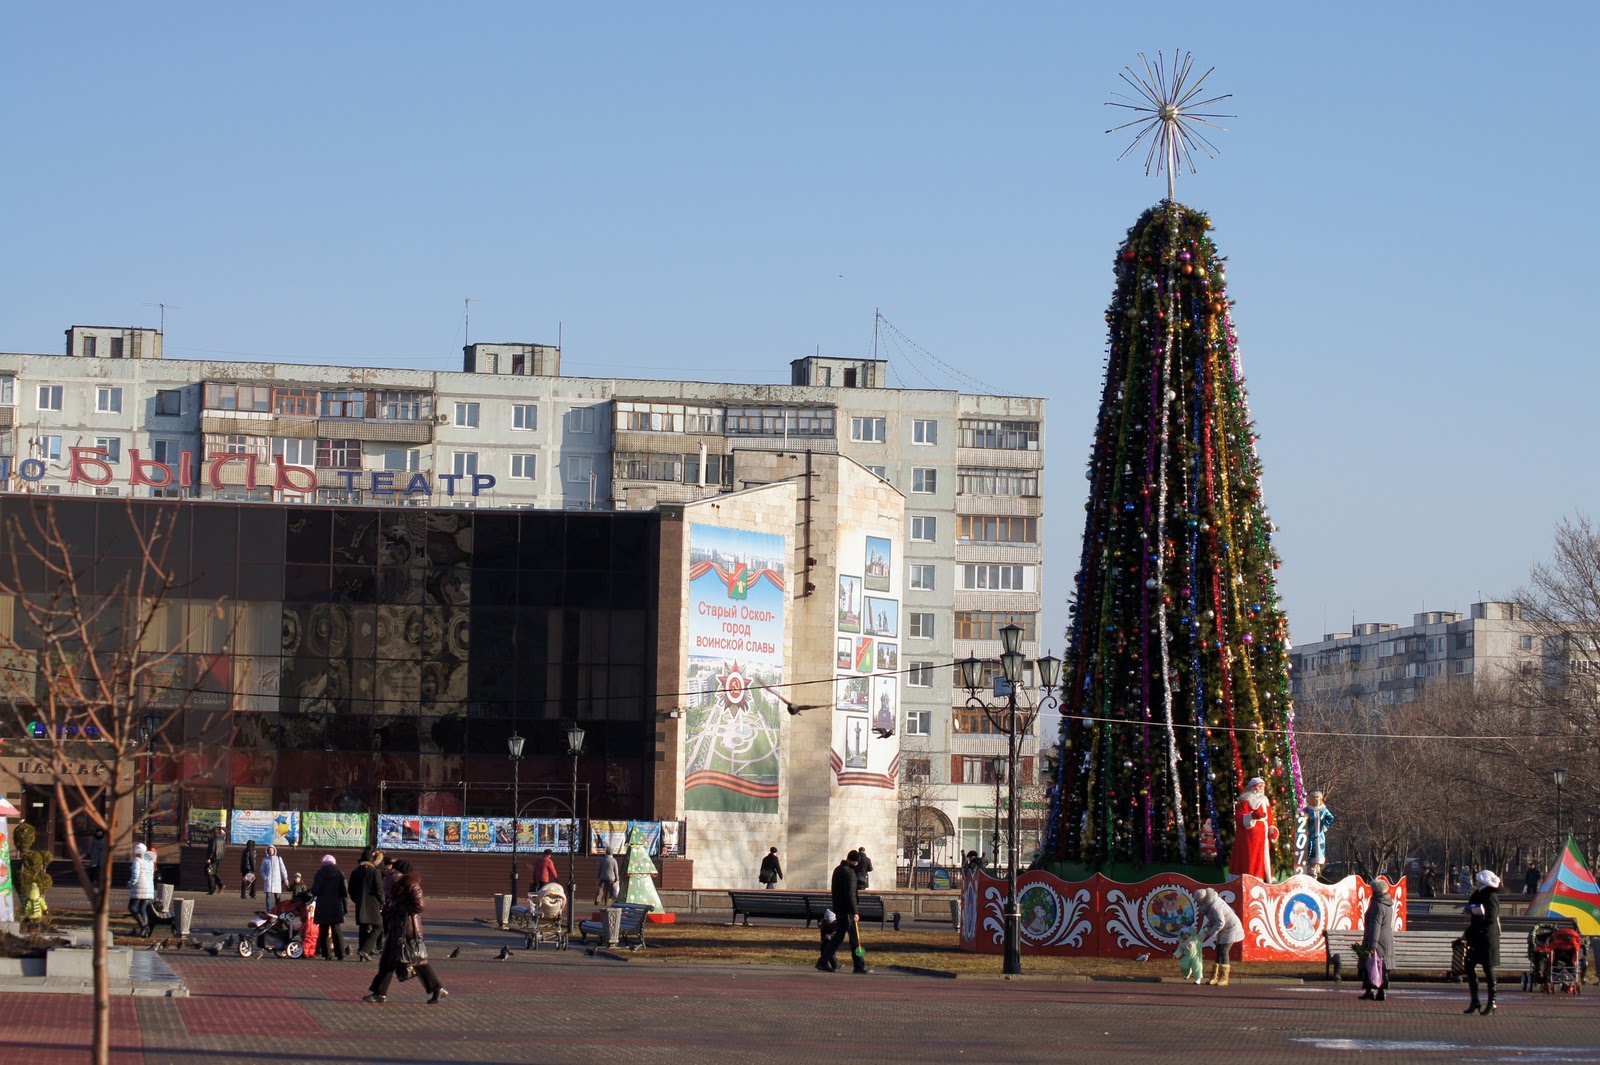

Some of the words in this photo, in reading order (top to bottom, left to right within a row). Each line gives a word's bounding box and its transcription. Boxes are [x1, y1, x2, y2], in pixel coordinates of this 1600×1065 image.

[68, 446, 318, 493] БЫЛЬ
[338, 472, 497, 496] ТЕАТР
[698, 601, 737, 620] Старый
[741, 605, 775, 622] Оскол-
[722, 622, 751, 637] город
[696, 635, 744, 651] ВОИНСКОЙ
[746, 641, 775, 654] СЛАВЫ
[468, 821, 489, 833] 5D
[467, 833, 490, 841] КИНО
